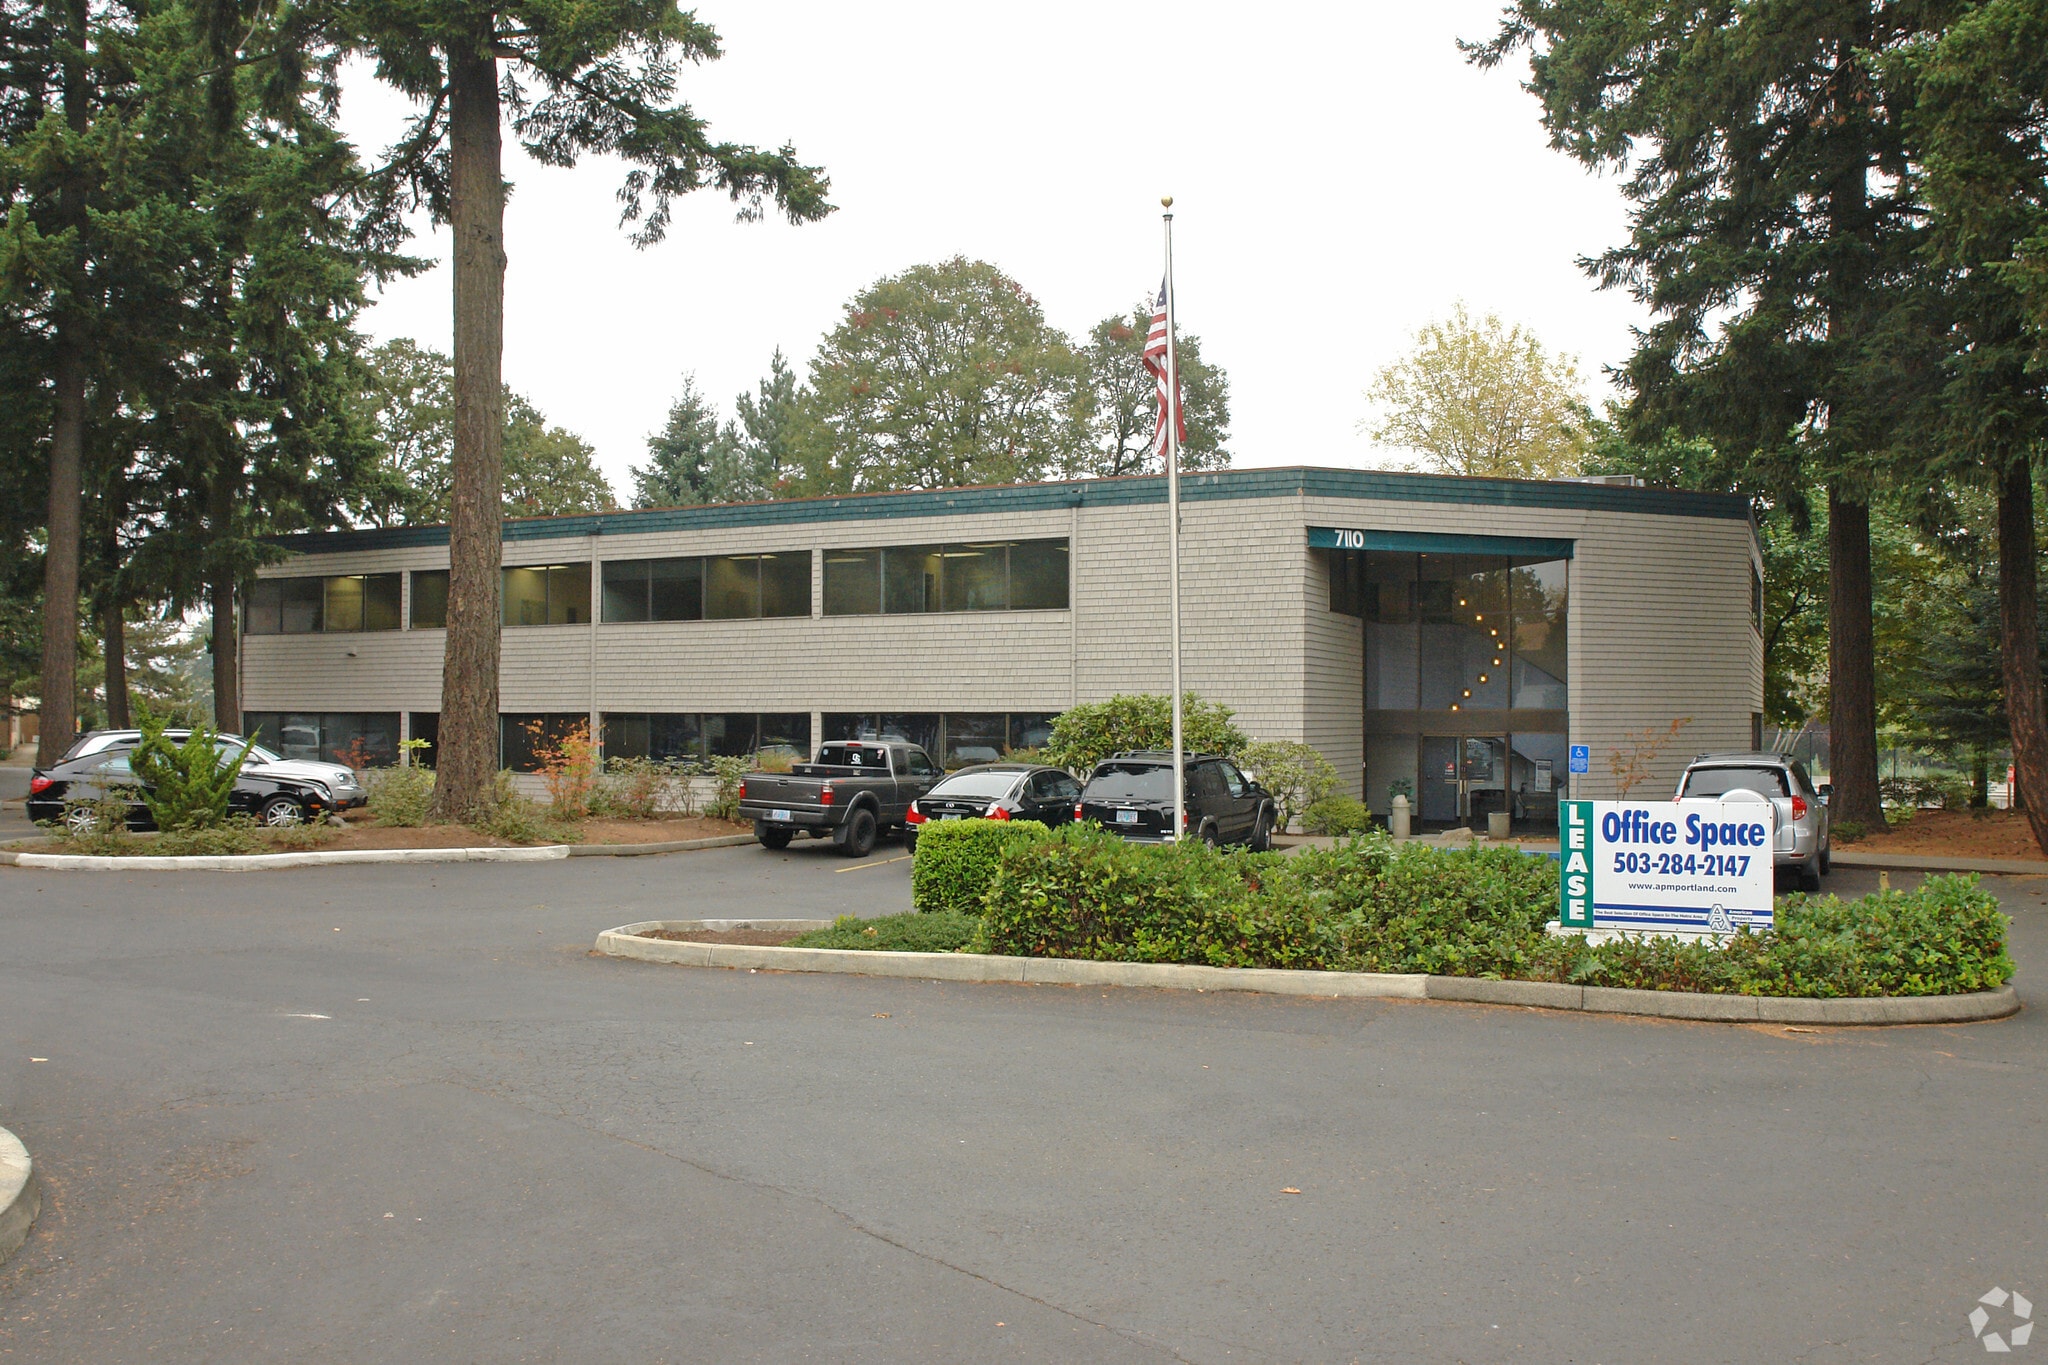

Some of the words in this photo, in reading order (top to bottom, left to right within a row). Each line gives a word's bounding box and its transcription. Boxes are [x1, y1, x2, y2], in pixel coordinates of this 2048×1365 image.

[1334, 529, 1364, 548] 7110
[1602, 809, 1677, 844] Office
[1685, 813, 1766, 852] Space
[1565, 804, 1589, 921] LEASE
[1613, 851, 1751, 877] 503-284-2147
[1628, 883, 1737, 893] www.apmportland.com
